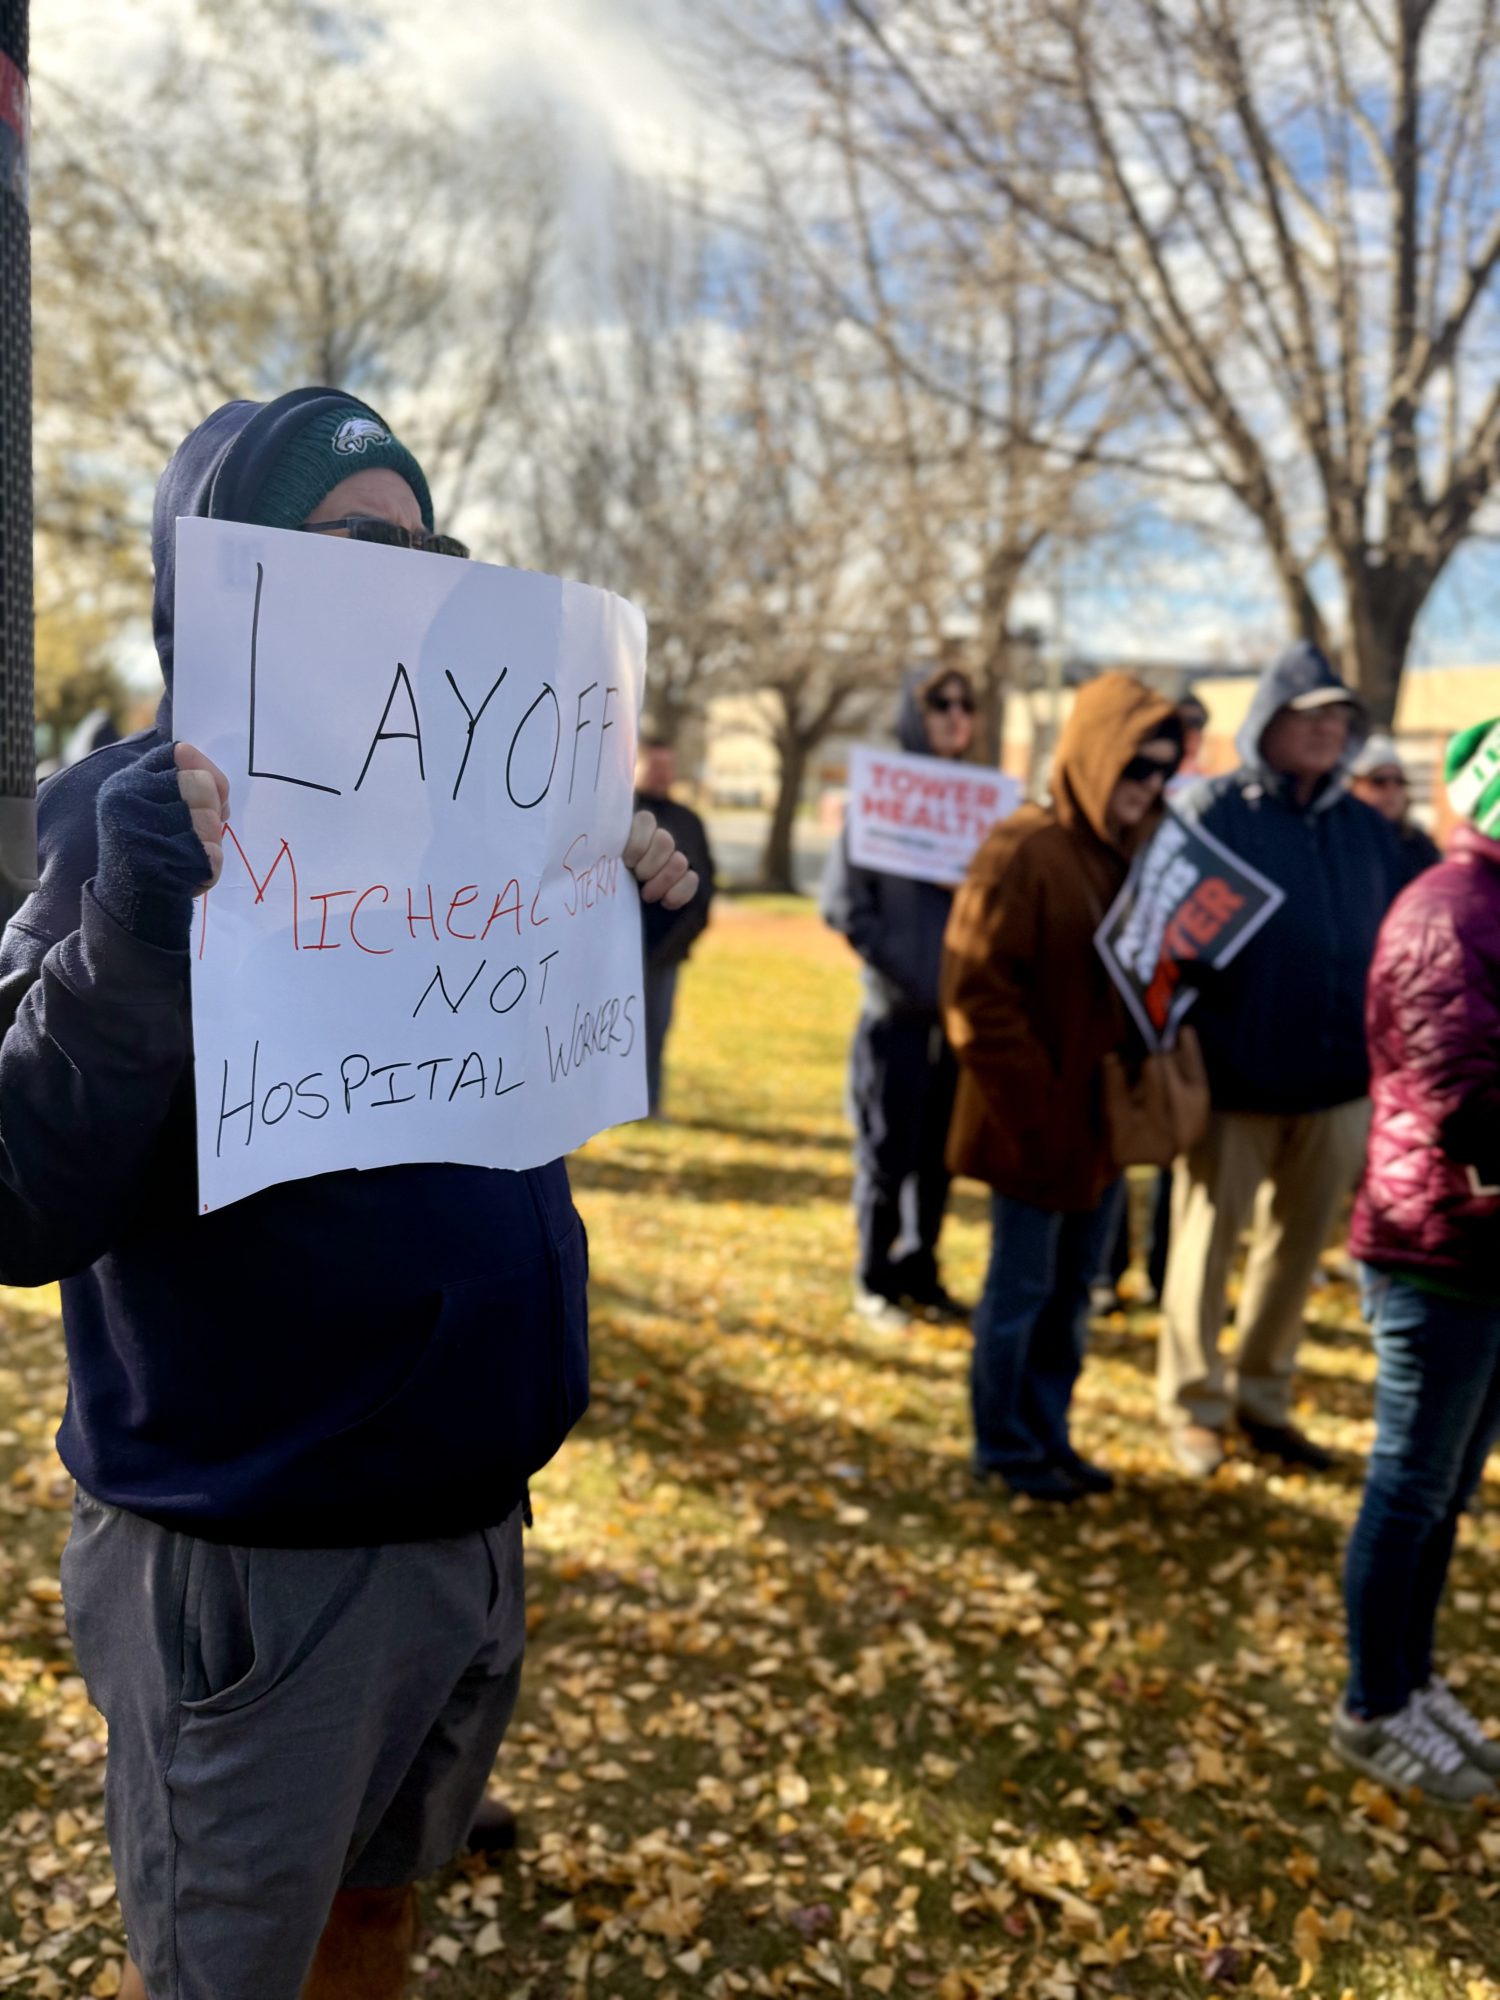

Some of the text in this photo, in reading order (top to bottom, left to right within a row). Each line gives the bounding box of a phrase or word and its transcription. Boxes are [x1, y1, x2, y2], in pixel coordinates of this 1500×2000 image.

[247, 561, 620, 810] LAYOFF
[868, 762, 1000, 810] TOWER
[412, 950, 560, 1019] NOT
[216, 994, 636, 1158] HOSPITAL WORKERS
